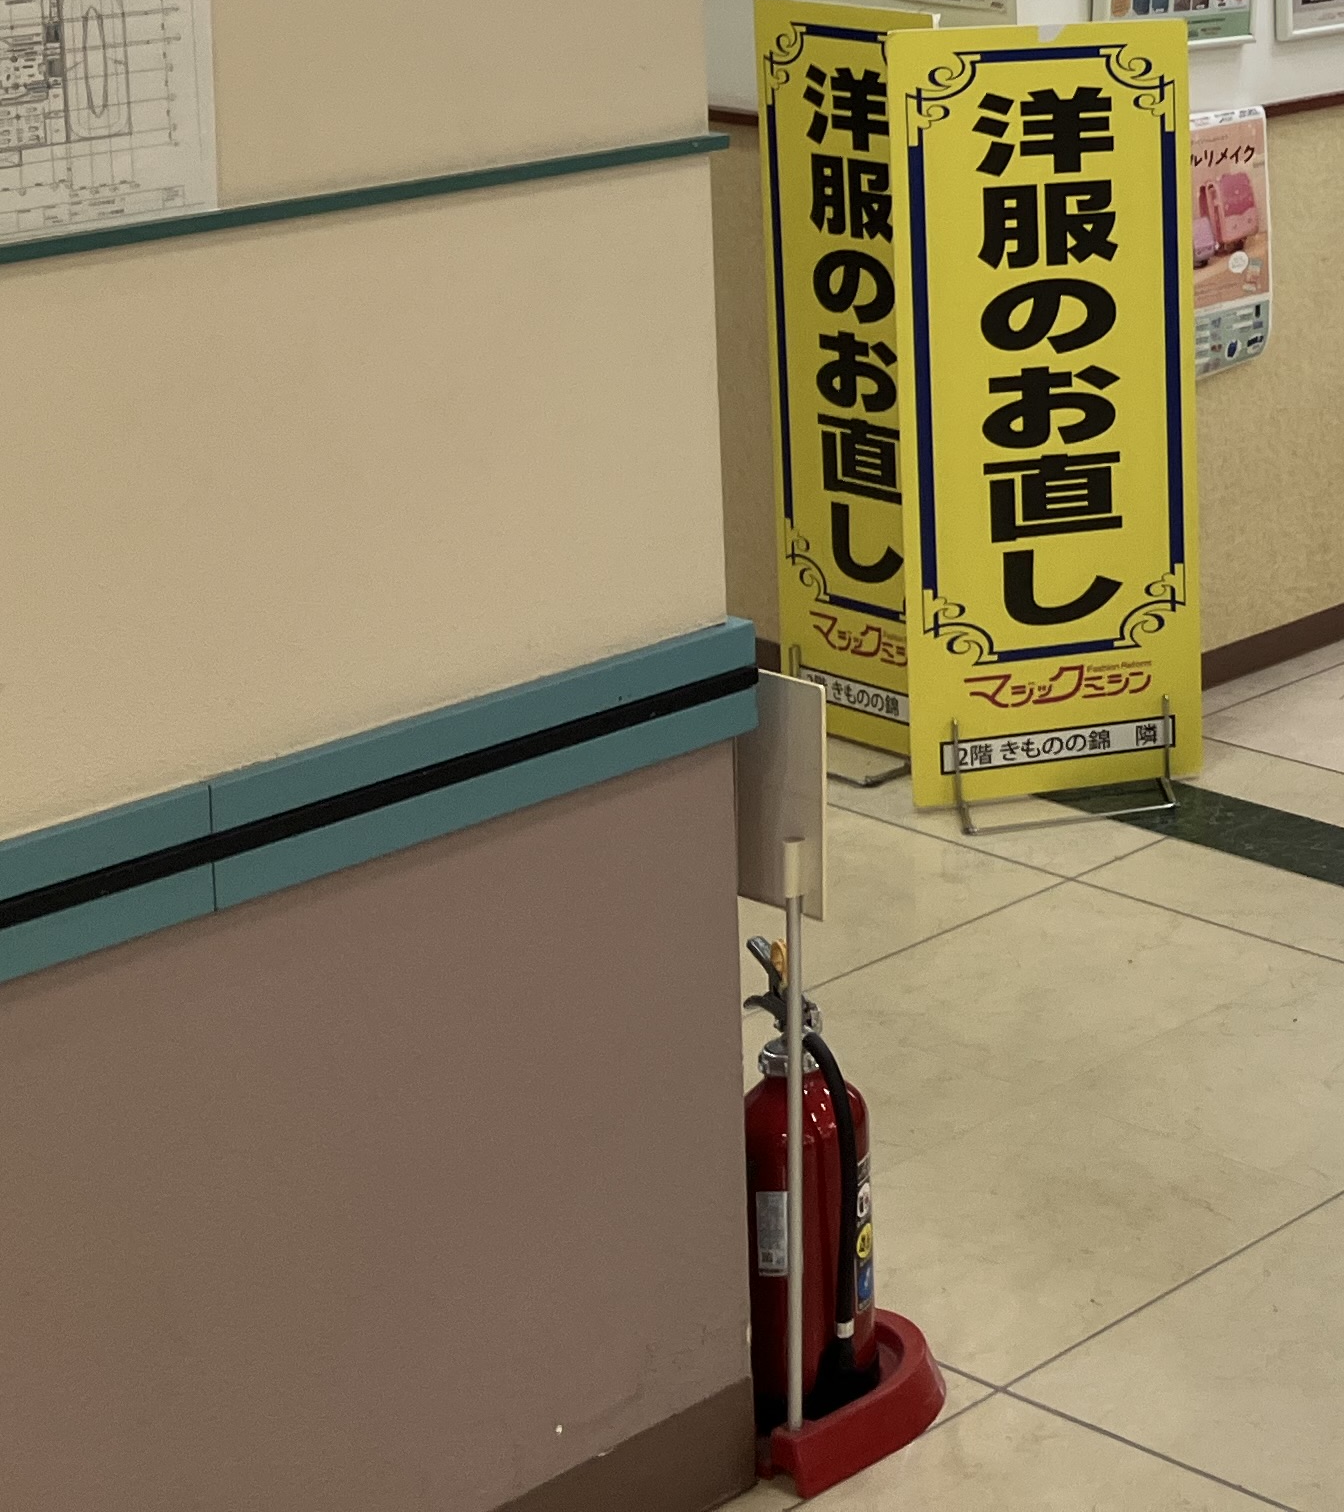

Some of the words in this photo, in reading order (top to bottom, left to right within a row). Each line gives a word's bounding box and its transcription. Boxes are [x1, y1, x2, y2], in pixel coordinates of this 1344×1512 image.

[801, 63, 906, 585] 洋服のお直し
[973, 84, 1124, 627] 洋服のお直し
[808, 609, 908, 667] マジックミシ
[963, 663, 1152, 709] マジックミシン
[1000, 729, 1111, 763] きものの錦
